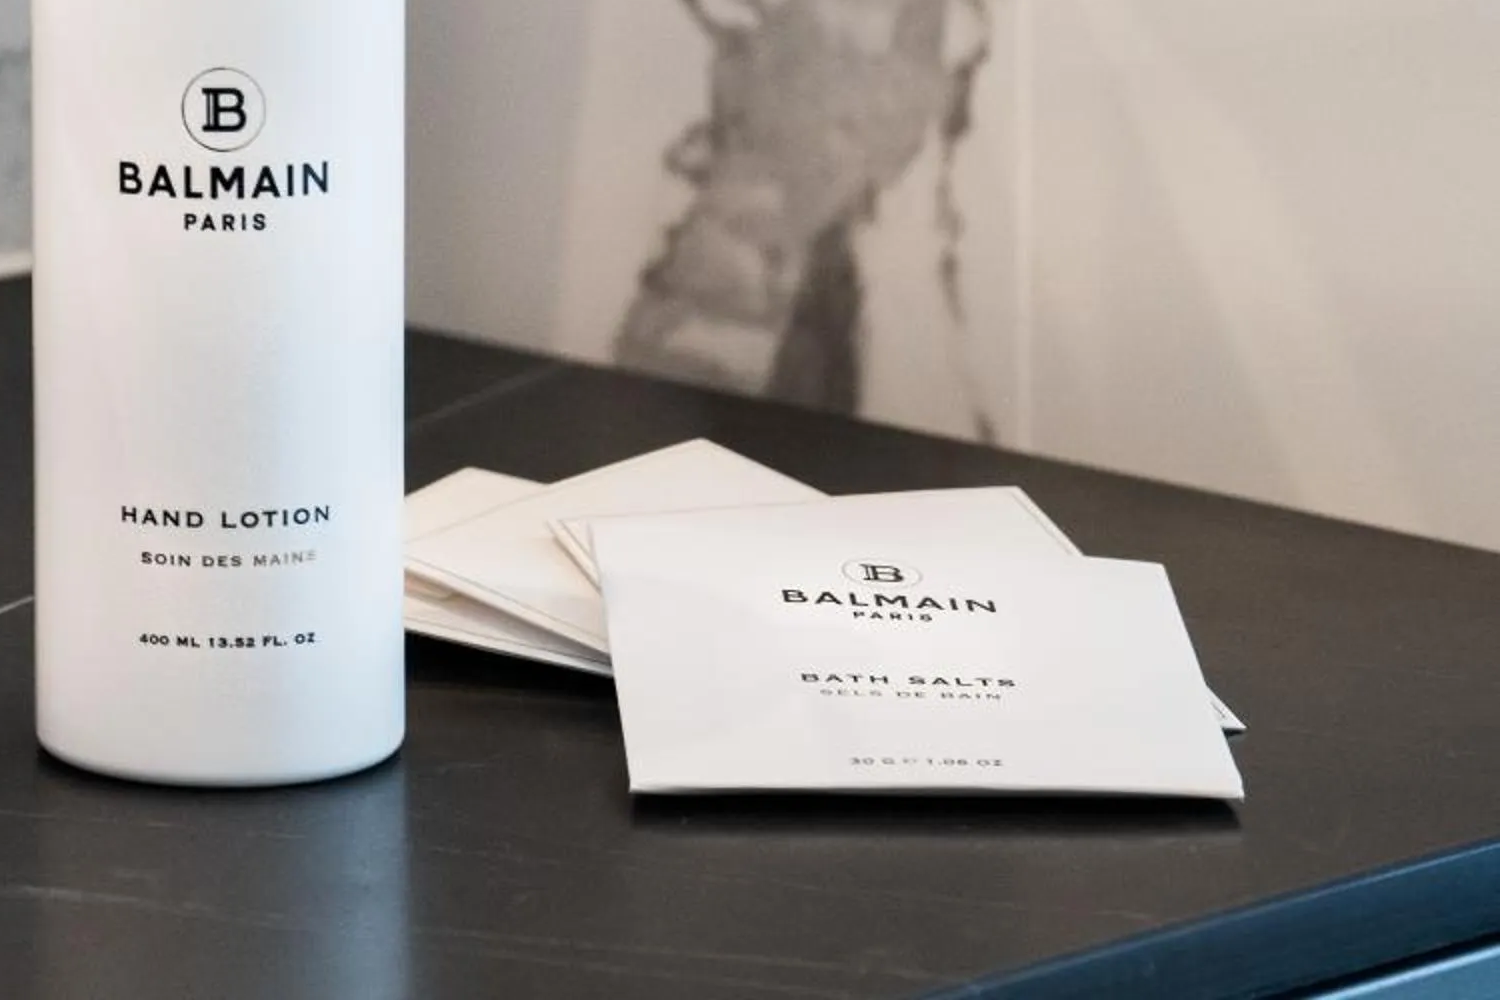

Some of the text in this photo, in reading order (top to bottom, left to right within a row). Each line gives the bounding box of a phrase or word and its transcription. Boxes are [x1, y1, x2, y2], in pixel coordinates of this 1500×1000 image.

[201, 87, 248, 133] B
[118, 160, 329, 201] BALMAIN
[183, 212, 268, 232] PARIS
[120, 505, 330, 530] HAND LOTION
[140, 550, 192, 568] SOIN
[200, 554, 243, 568] DES
[859, 562, 905, 584] B
[781, 588, 998, 614] BALMAIN
[852, 610, 934, 623] PARIS
[138, 631, 317, 650] 400 ML 13.52 FL. OZ
[800, 672, 1017, 688] BATH SALTS
